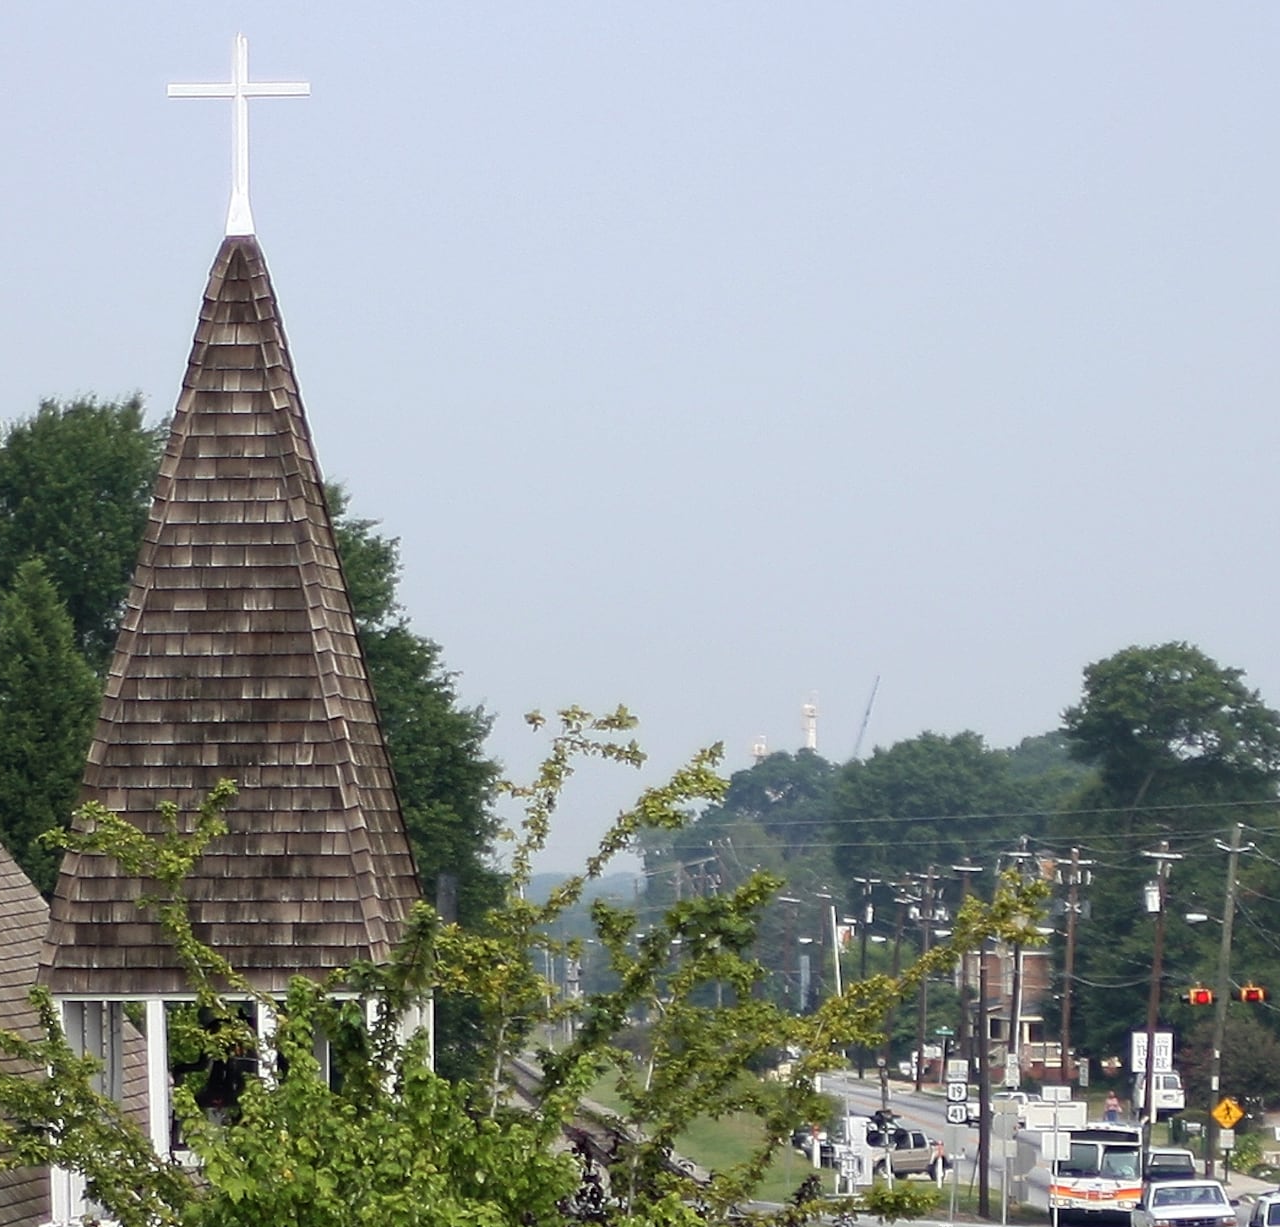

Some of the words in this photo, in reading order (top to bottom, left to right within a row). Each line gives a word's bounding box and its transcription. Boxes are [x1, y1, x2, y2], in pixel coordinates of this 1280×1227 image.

[1136, 1044, 1169, 1056] THIFT
[951, 1086, 963, 1098] 19
[950, 1108, 964, 1120] 41
